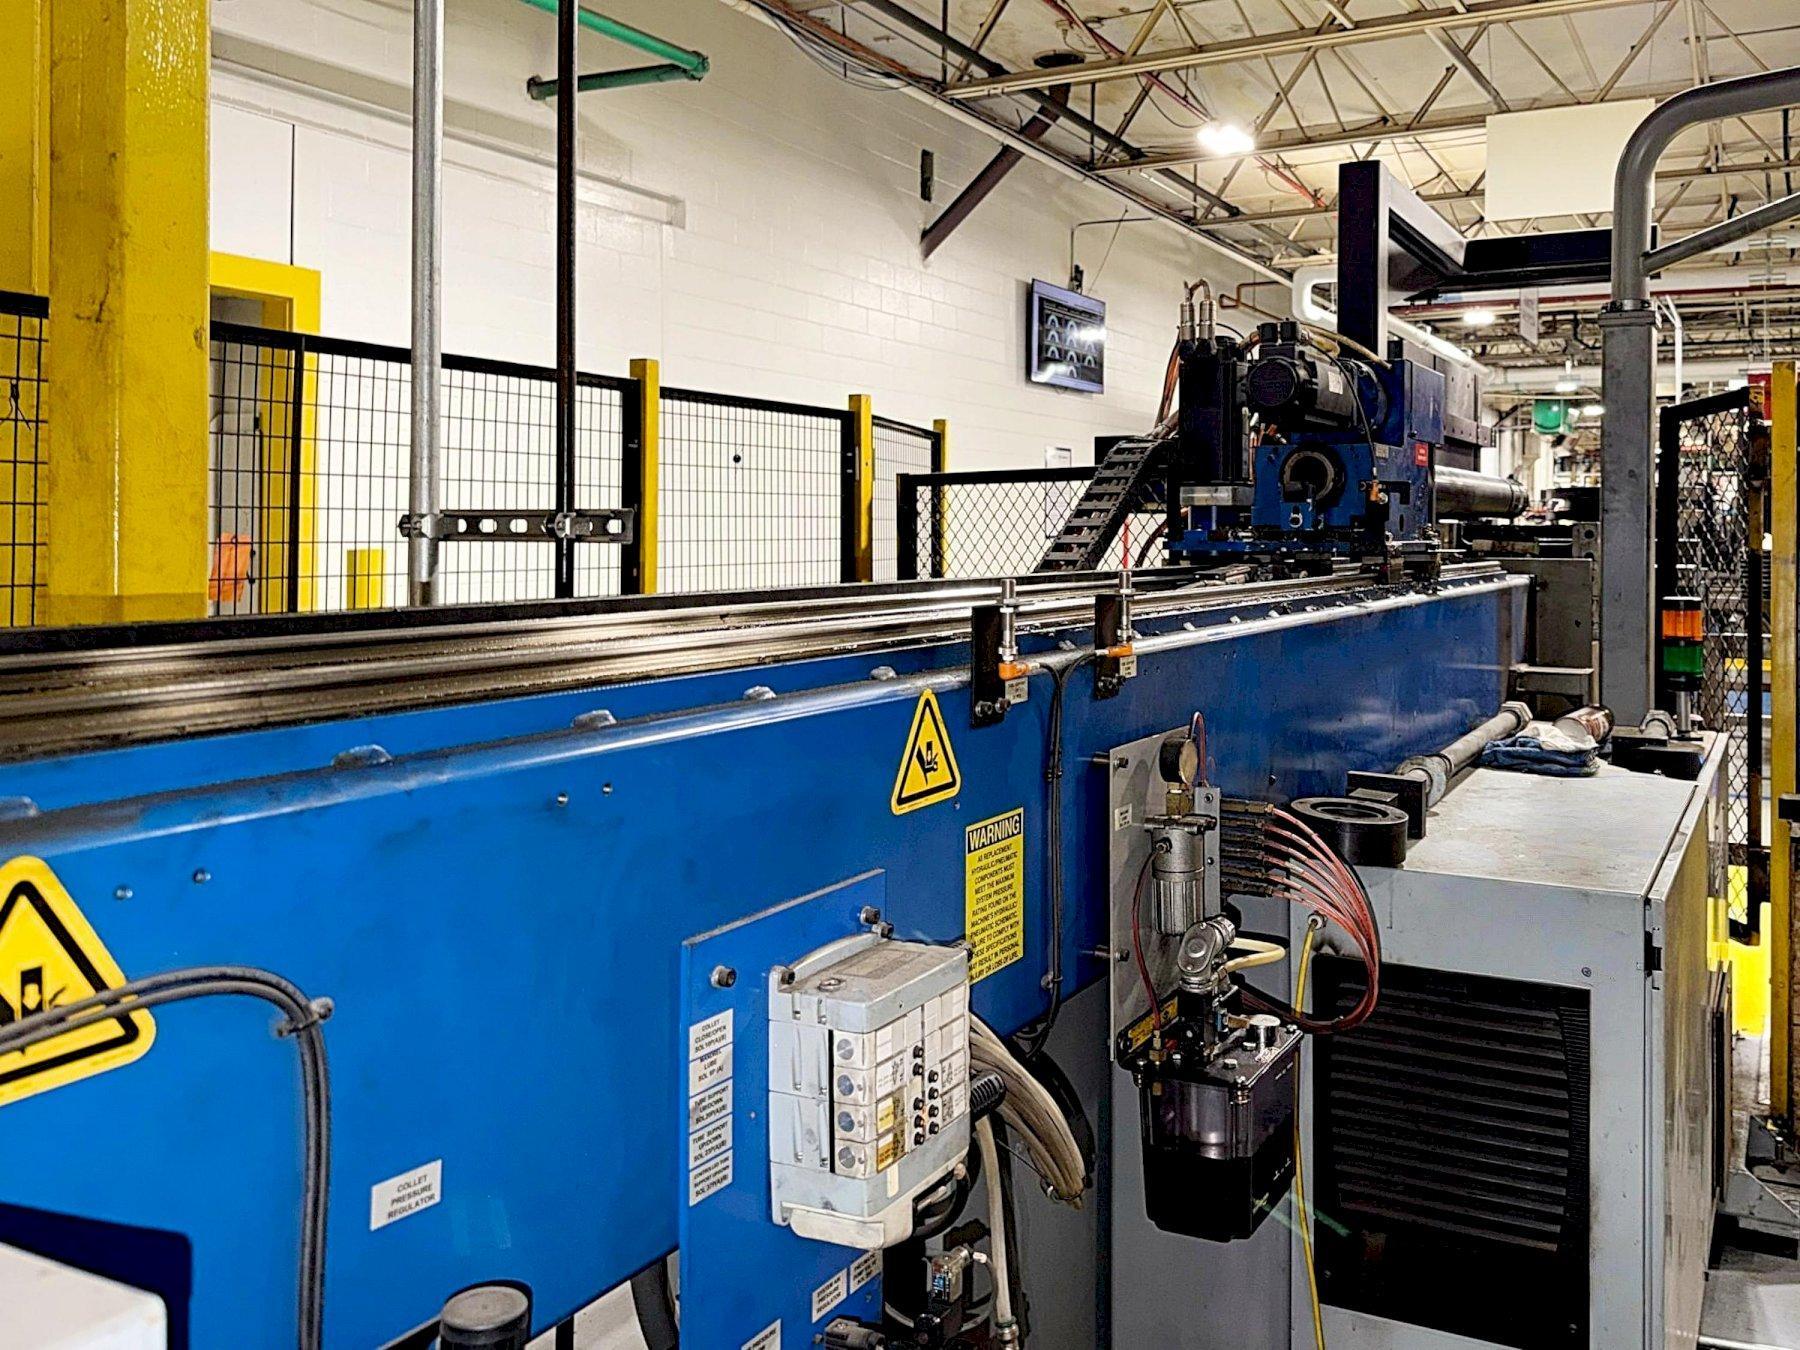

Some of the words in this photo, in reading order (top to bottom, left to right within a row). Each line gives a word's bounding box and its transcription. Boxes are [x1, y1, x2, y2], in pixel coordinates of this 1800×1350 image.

[969, 814, 1020, 852] WARNING
[993, 883, 1013, 898] PRESSURE
[391, 1183, 432, 1207] PRESSURE
[397, 1174, 427, 1193] COLLET
[388, 1193, 435, 1219] REGULATOR
